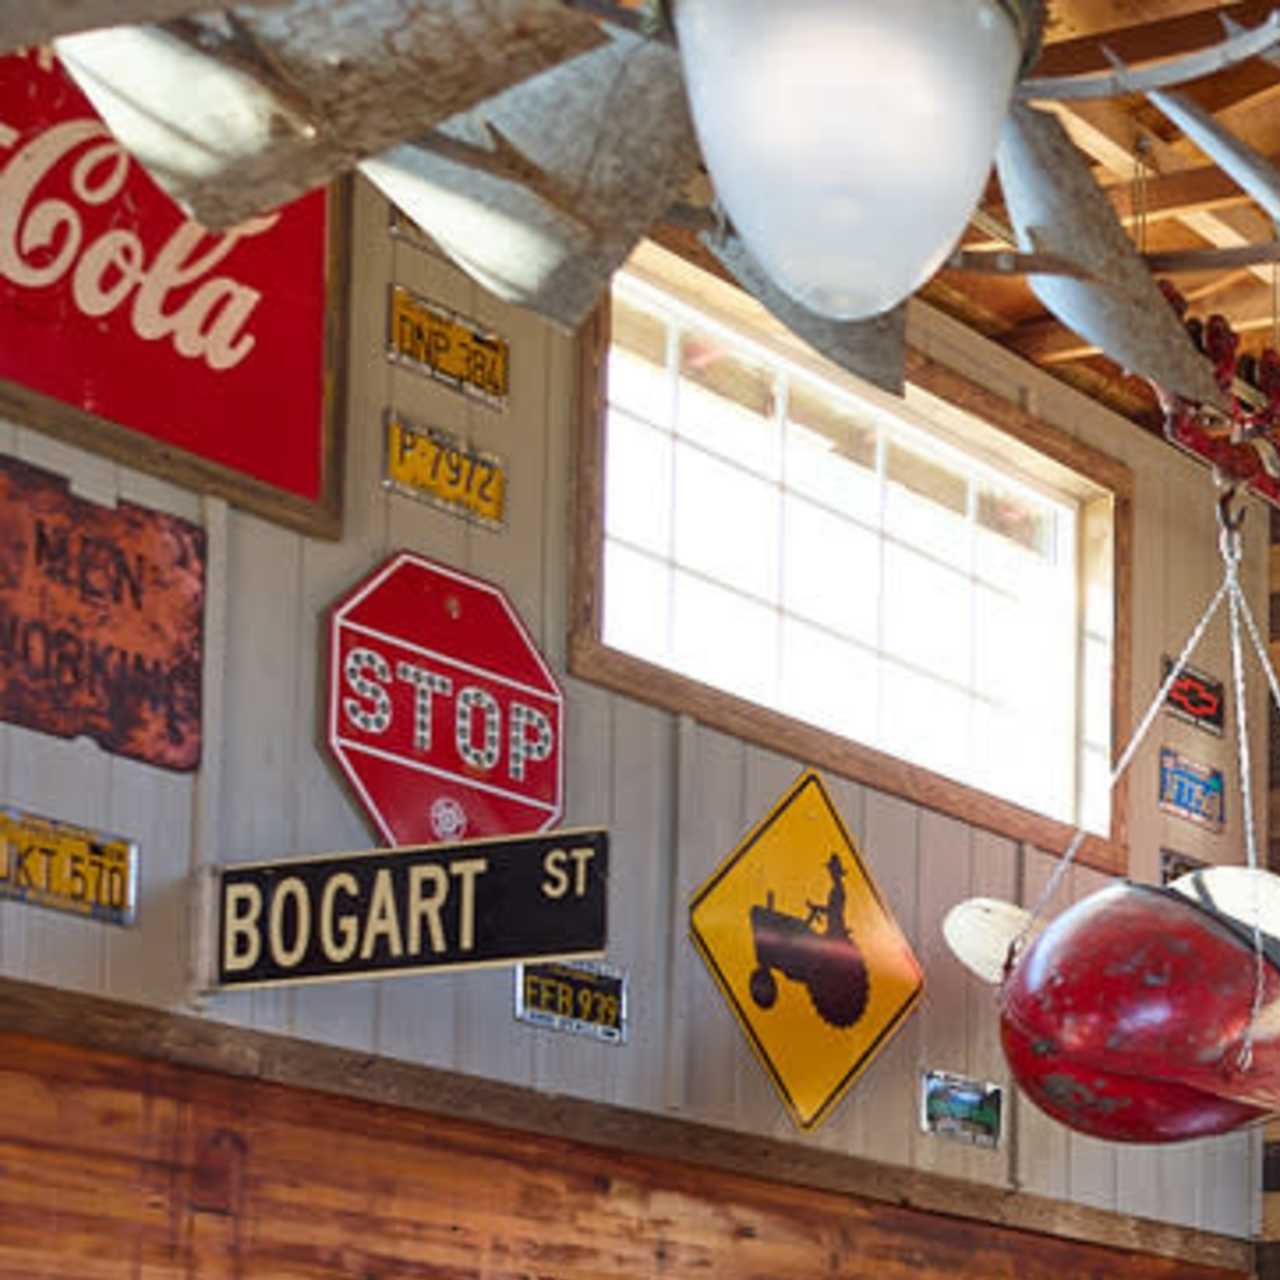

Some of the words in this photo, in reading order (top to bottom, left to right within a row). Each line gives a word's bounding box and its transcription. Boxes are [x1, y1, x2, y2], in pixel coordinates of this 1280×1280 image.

[342, 647, 552, 780] STOP
[224, 858, 487, 971] BOGART
[541, 847, 595, 899] ST
